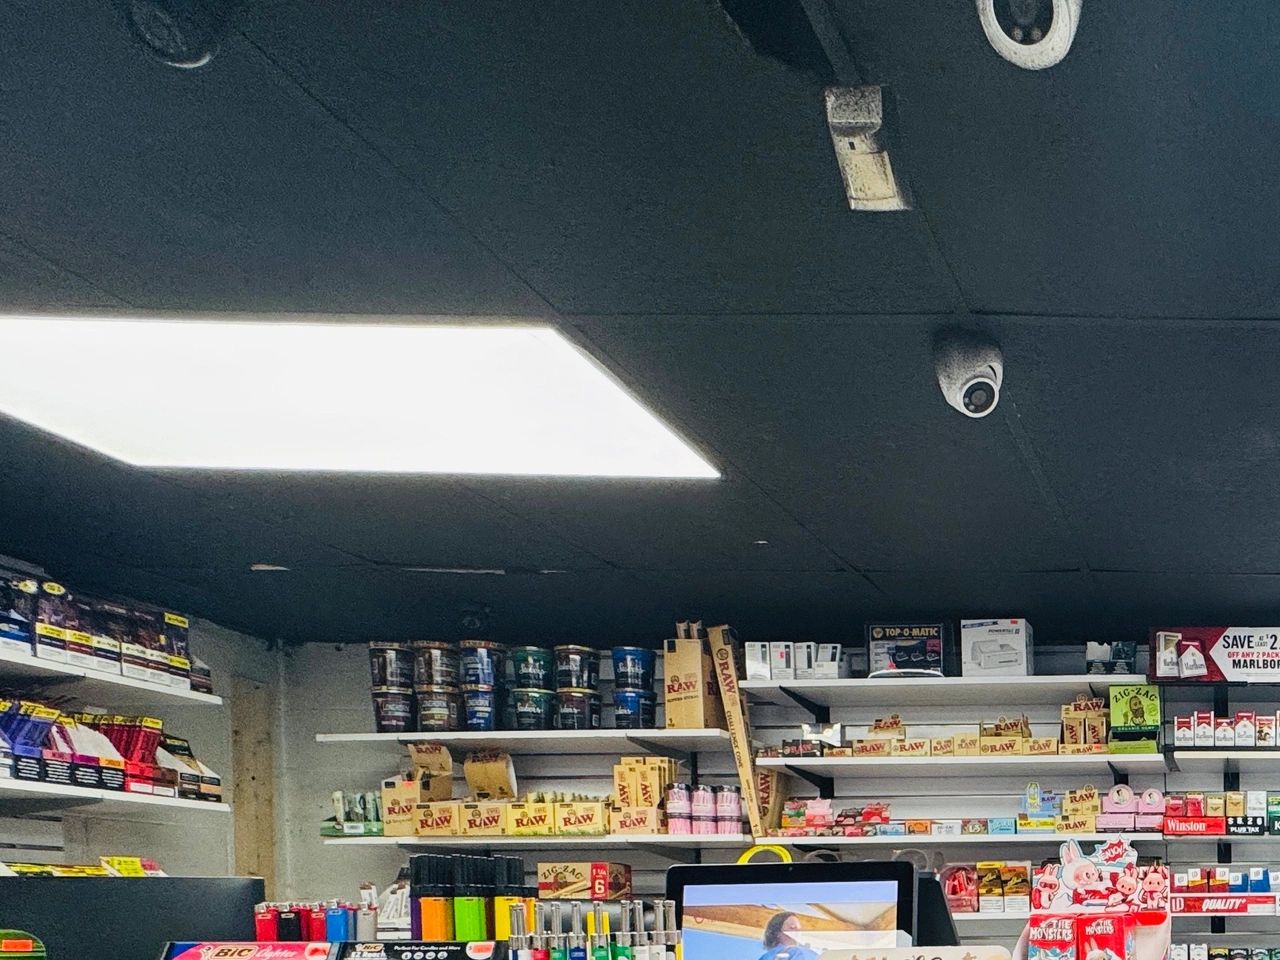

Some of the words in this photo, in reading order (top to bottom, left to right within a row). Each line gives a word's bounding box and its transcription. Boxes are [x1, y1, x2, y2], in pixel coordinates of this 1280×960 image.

[1222, 635, 1254, 650] SAVE
[719, 661, 737, 695] RAW
[667, 680, 698, 694] RAW
[1073, 702, 1102, 712] RAW
[900, 742, 926, 753] RAW
[758, 771, 771, 806] RAW
[1070, 792, 1096, 804] RAW
[419, 815, 452, 829] RAW
[467, 815, 500, 829] RAW
[563, 813, 594, 827] RAW
[619, 817, 648, 829] RAW
[1167, 818, 1206, 832] Winston
[594, 880, 605, 893] 6
